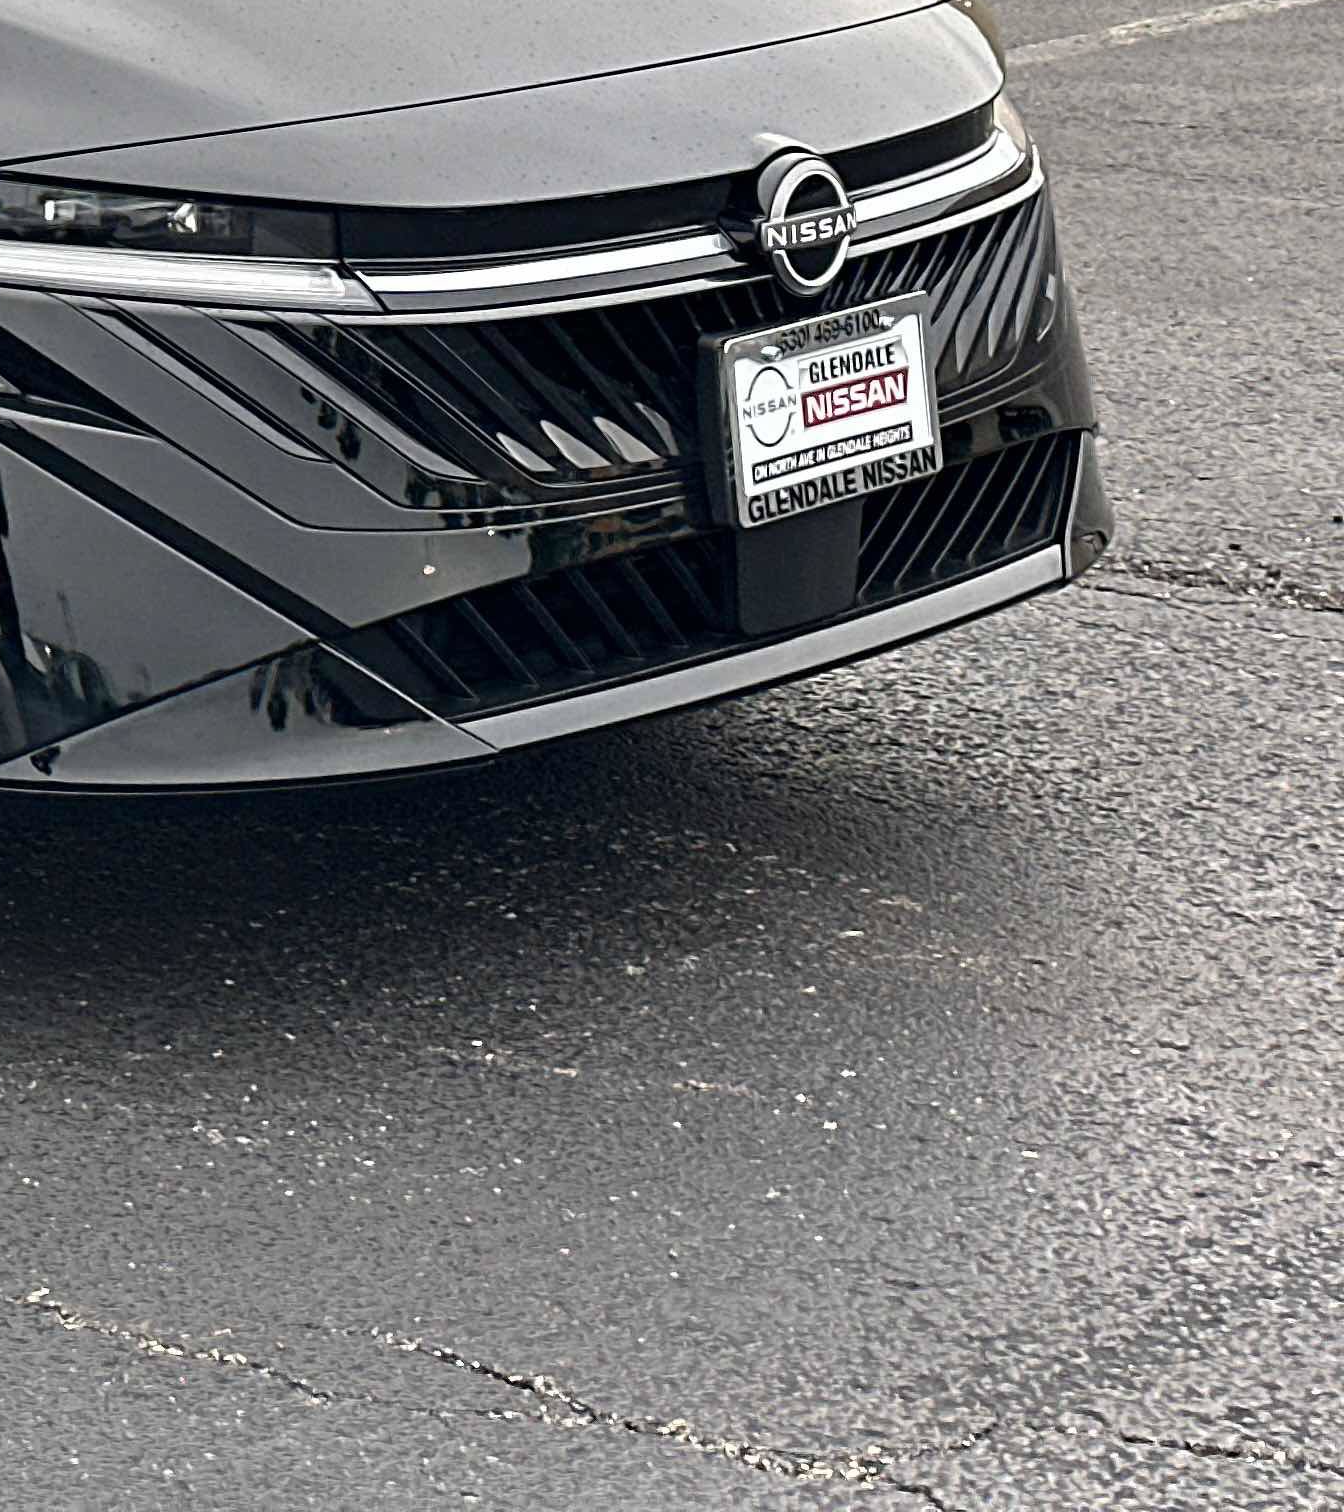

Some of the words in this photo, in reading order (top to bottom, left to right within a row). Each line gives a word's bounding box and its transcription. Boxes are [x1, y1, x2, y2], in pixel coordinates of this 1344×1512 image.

[767, 207, 857, 248] NISSAN
[814, 308, 881, 344] 469-6100
[808, 342, 896, 385] GLENDALE
[742, 394, 798, 419] NISSAN
[805, 372, 907, 425] NISSAN
[747, 468, 858, 524] GLENDALE
[863, 445, 937, 490] NISSAN
